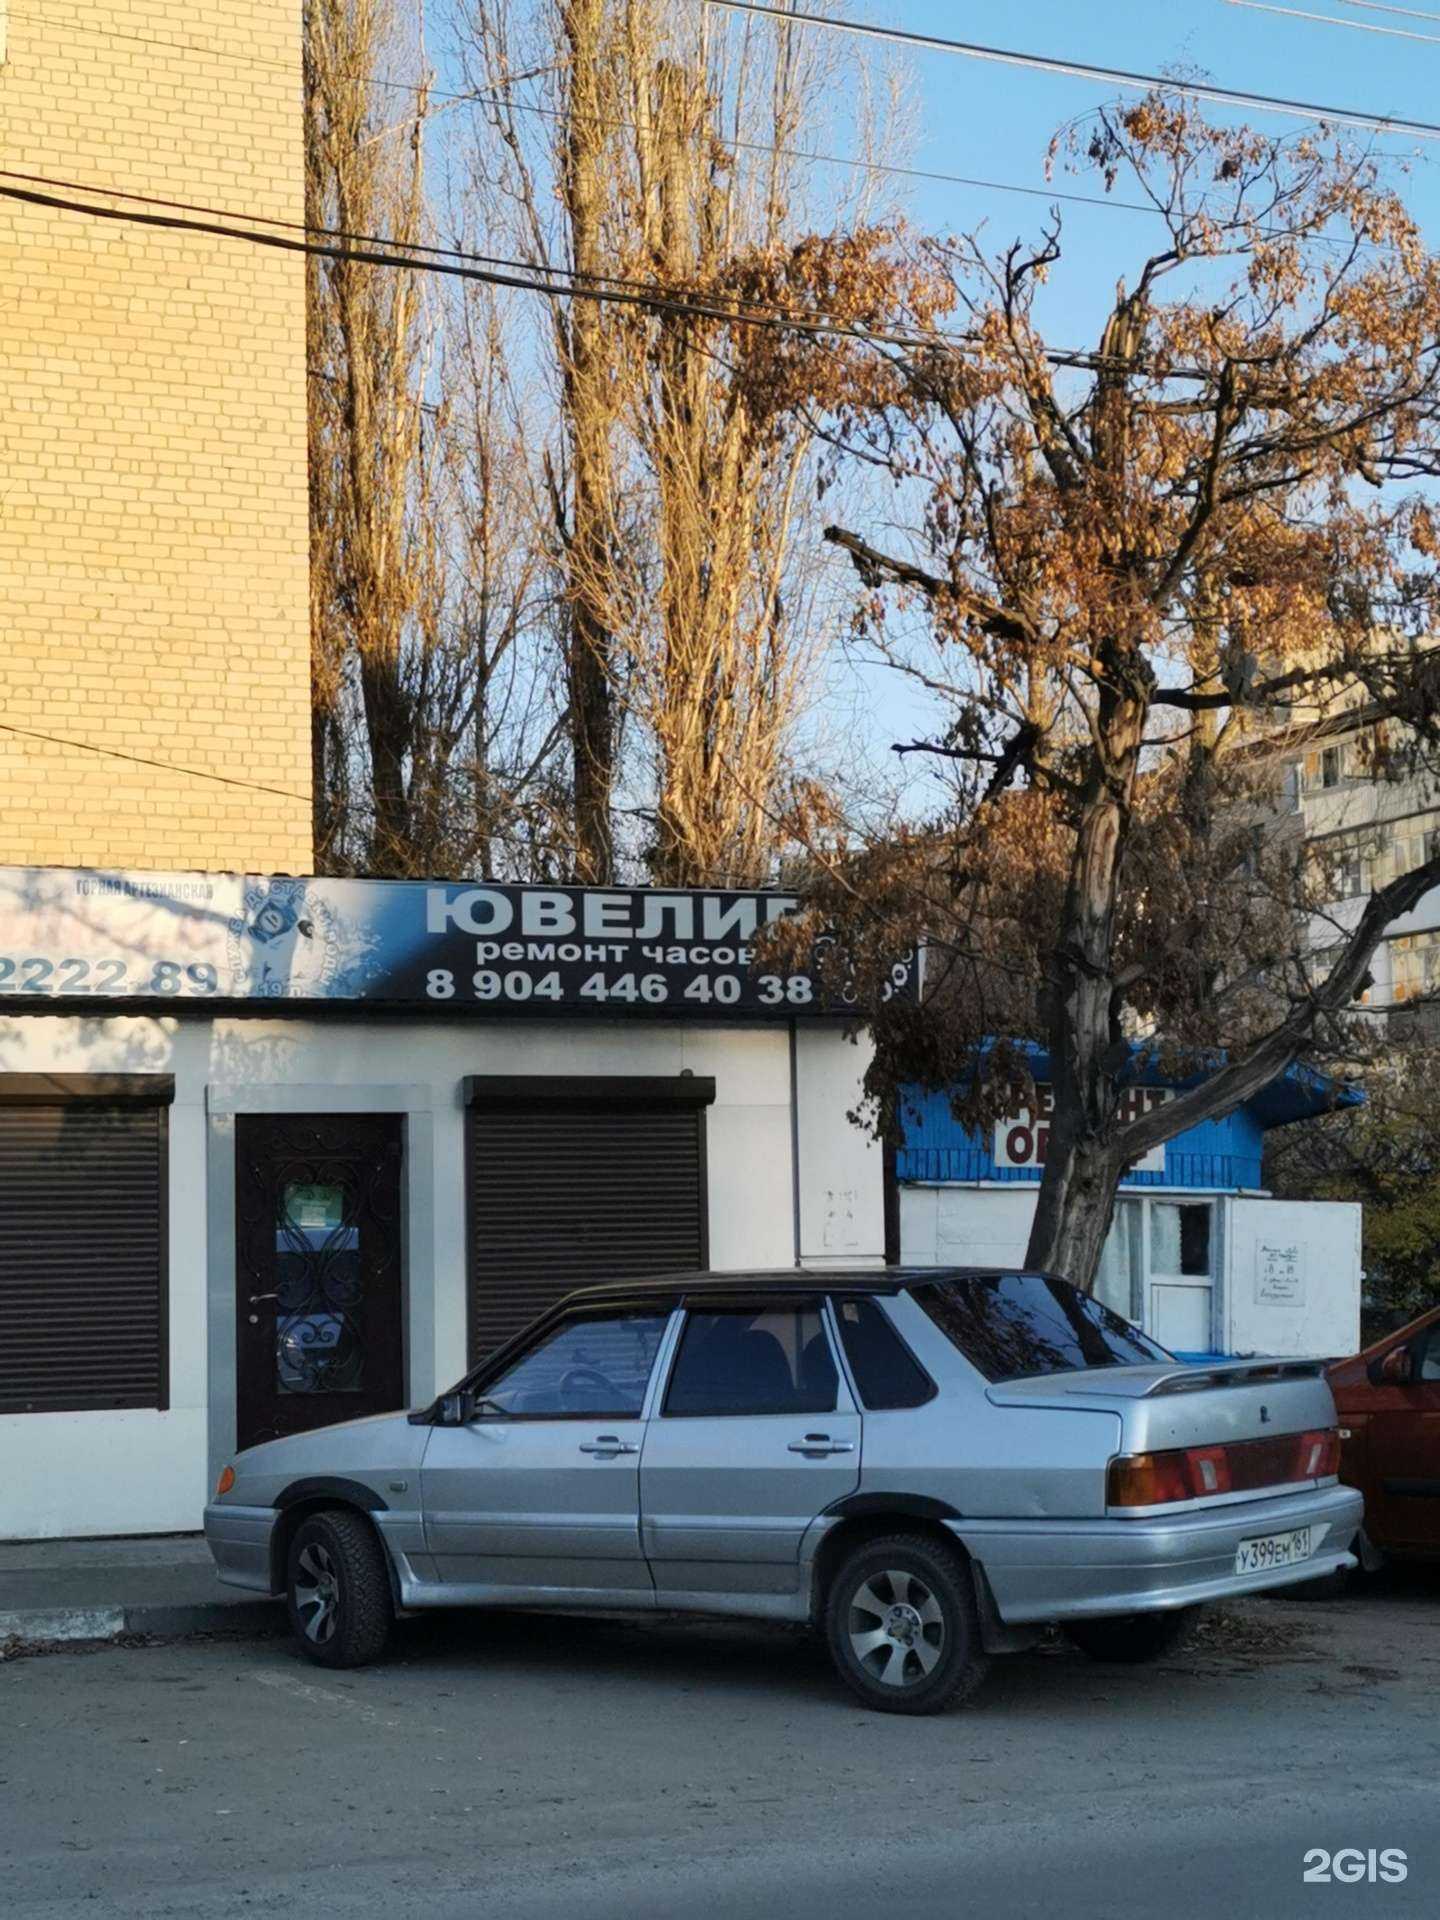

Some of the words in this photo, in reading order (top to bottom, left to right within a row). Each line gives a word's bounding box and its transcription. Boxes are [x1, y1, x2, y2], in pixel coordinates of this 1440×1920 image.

[476, 941, 629, 965] ремонт
[150, 960, 218, 995] 89
[426, 969, 456, 999] 8
[472, 970, 564, 1000] 904
[580, 972, 669, 1002] 446
[684, 974, 741, 1003] 40
[757, 975, 813, 1004] 38
